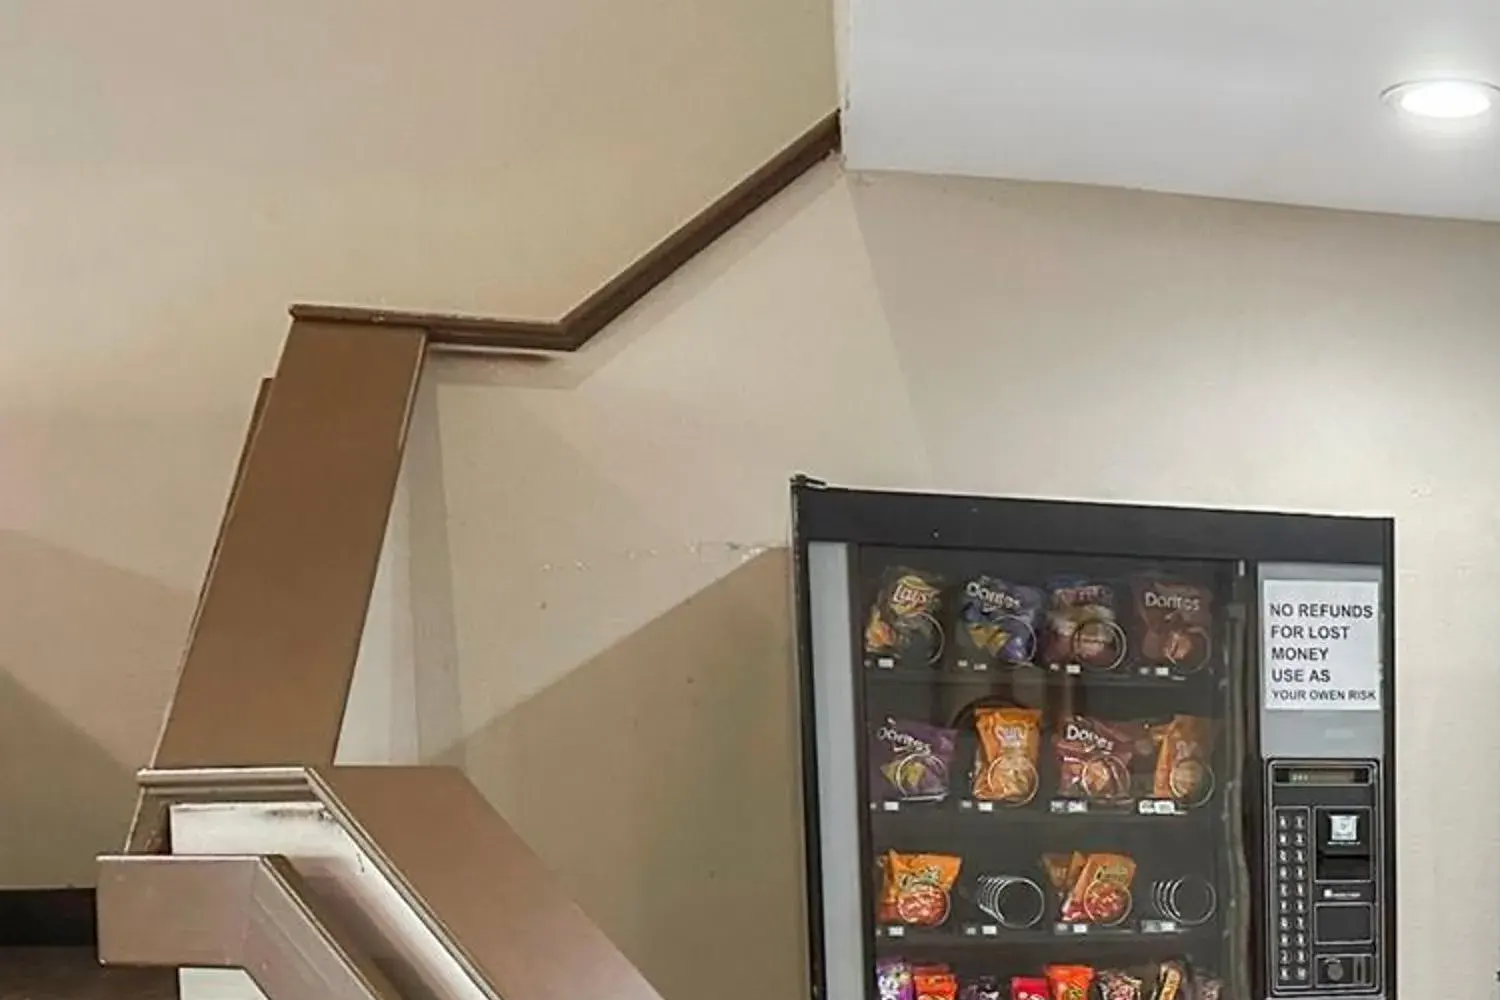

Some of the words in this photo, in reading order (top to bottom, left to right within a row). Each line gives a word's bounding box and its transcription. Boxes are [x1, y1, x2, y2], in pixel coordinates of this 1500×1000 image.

[1145, 591, 1200, 612] Doritos
[1270, 603, 1294, 617] NO
[1298, 603, 1374, 619] REFUNDS
[1270, 625, 1304, 639] FOR
[1308, 625, 1351, 640] LOST
[1271, 647, 1329, 661] MONEY
[1271, 669, 1304, 683] USE
[1309, 669, 1332, 683] AS
[1272, 690, 1306, 701] YOUR
[1309, 690, 1346, 701] OWEN
[1348, 690, 1377, 701] RISK
